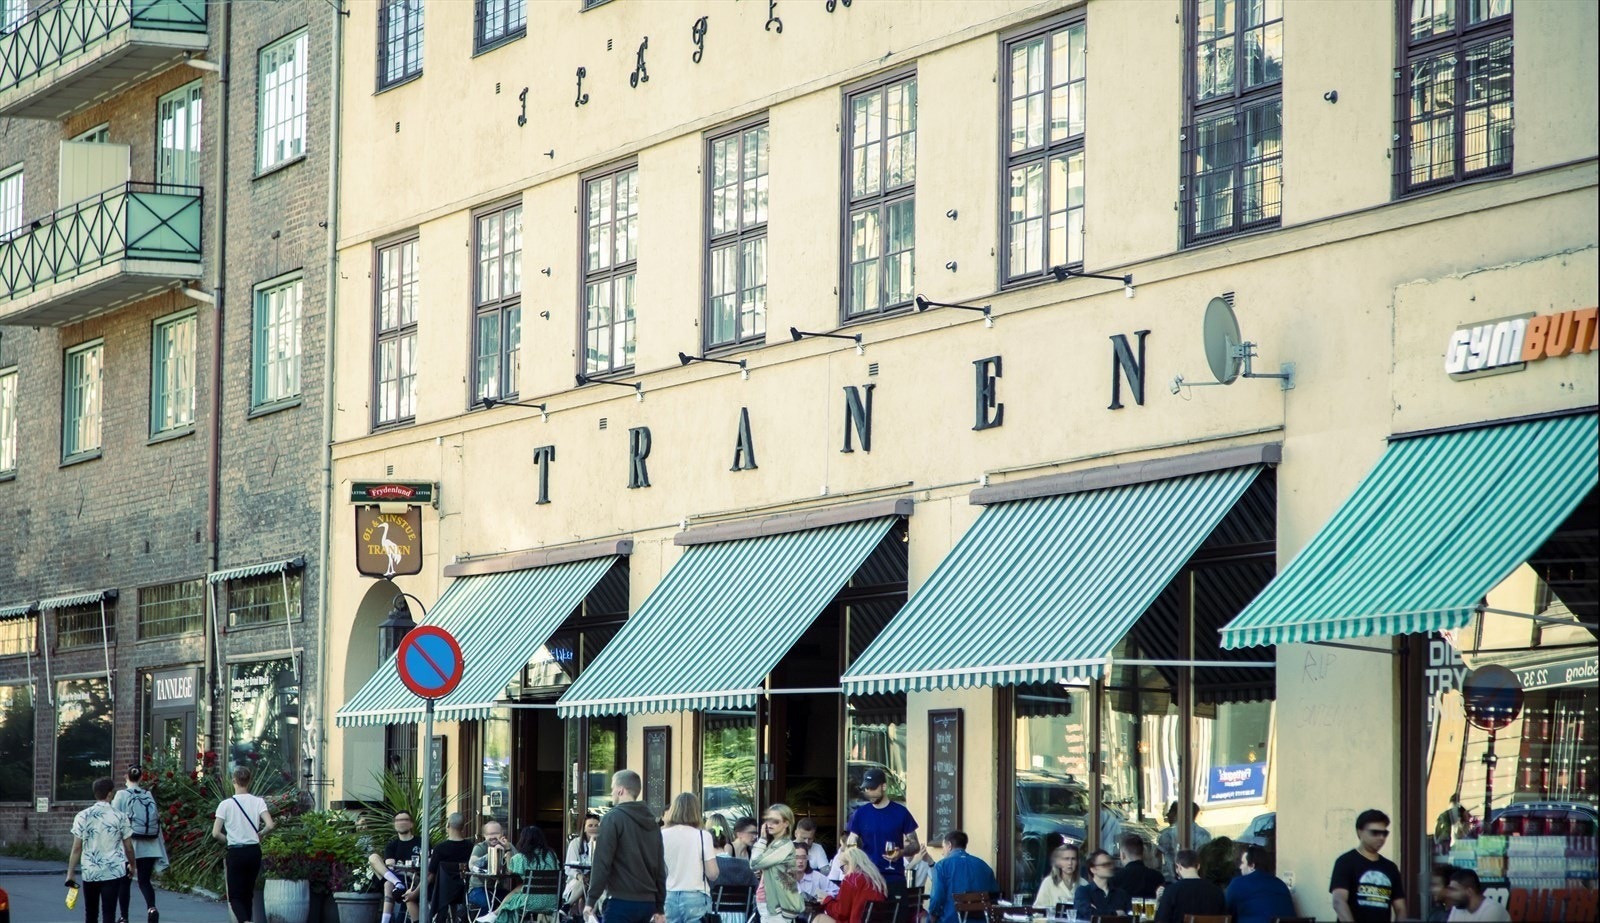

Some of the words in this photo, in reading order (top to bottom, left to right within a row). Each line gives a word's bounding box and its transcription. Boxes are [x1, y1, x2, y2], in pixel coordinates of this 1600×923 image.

[533, 329, 1151, 505] TRANEN
[371, 486, 411, 497] Frydenlund
[363, 527, 374, 541] ØL
[371, 520, 378, 528] &
[377, 514, 416, 541] VINSTUE
[368, 544, 411, 555] TRANEN
[156, 676, 193, 701] TANNLEGE
